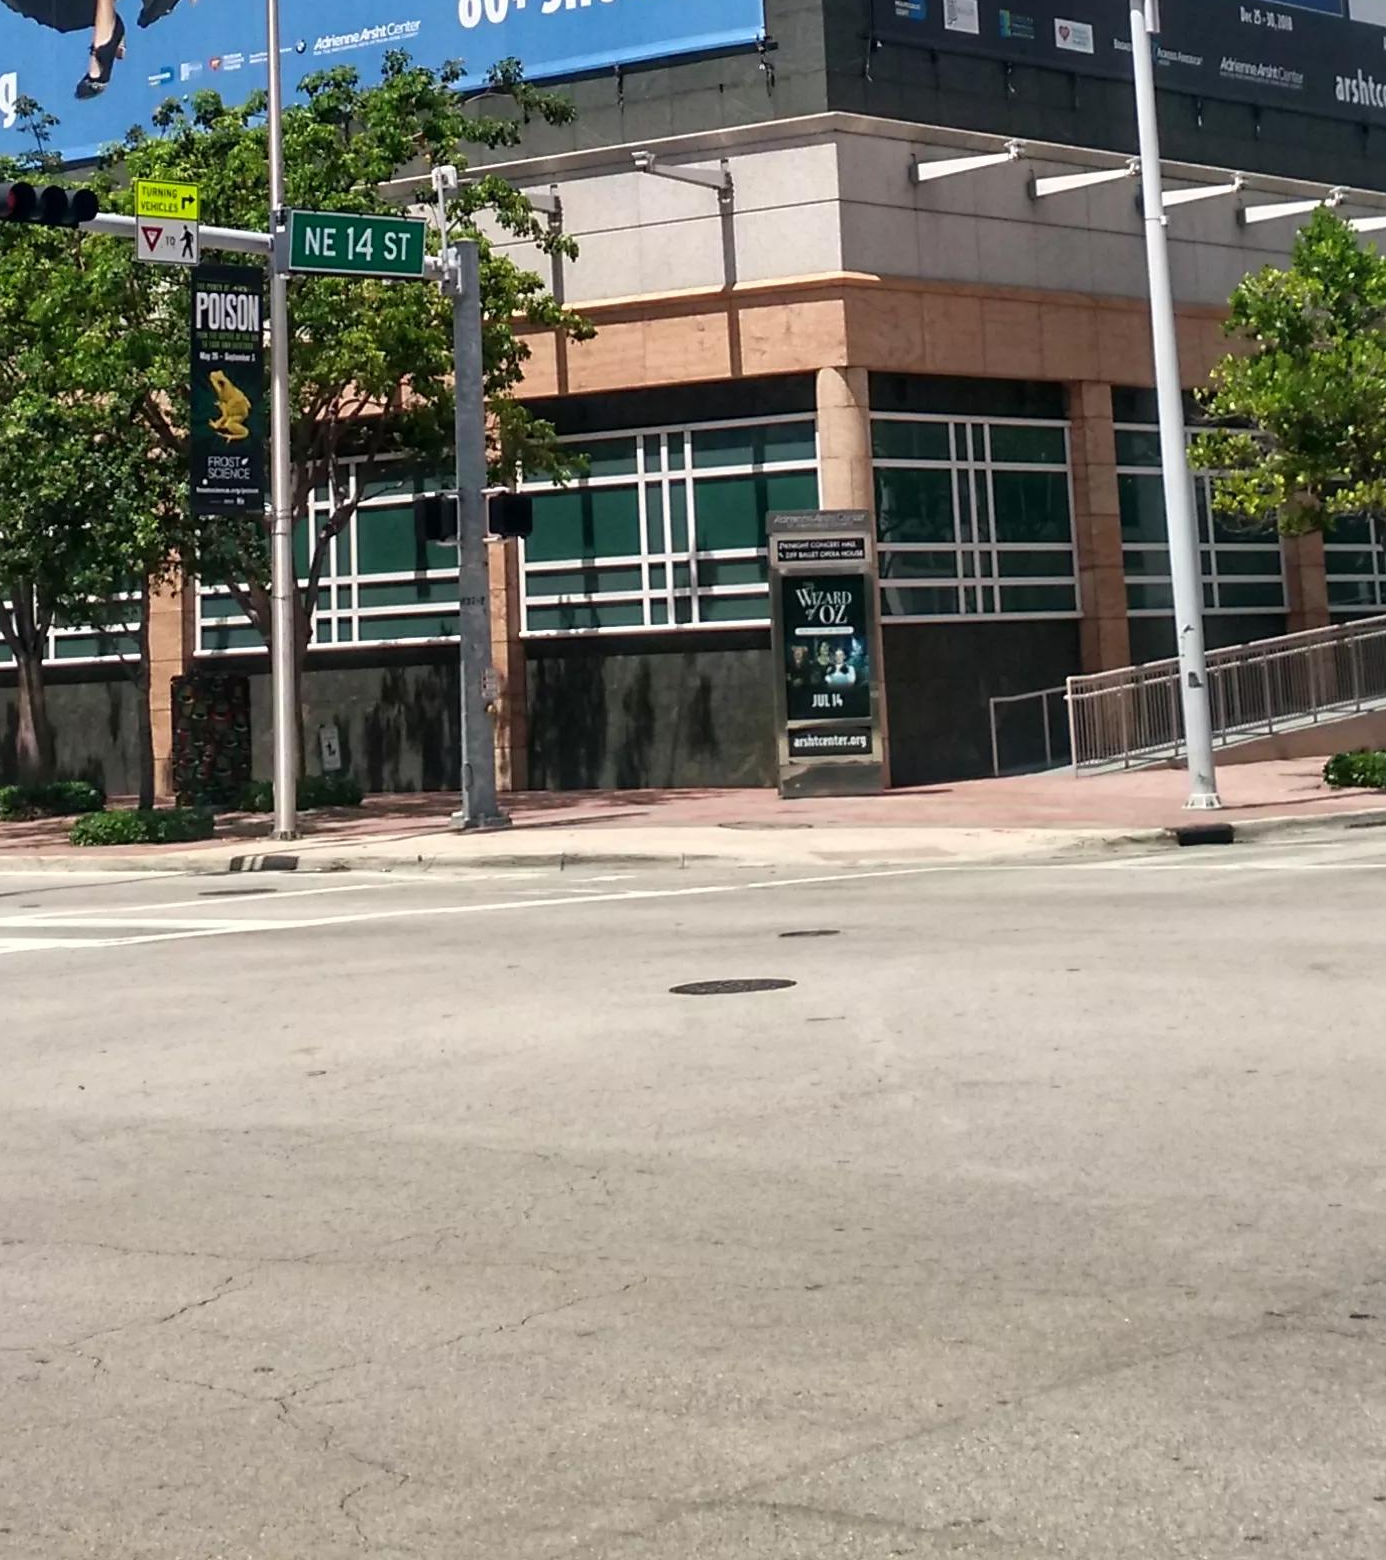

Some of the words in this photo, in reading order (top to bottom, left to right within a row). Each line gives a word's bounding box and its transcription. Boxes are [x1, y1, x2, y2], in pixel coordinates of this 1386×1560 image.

[313, 32, 360, 51] Adrienne
[360, 25, 387, 41] Arsht
[387, 19, 421, 36] Center
[1220, 56, 1257, 76] Adrienne
[1278, 66, 1304, 83] Center
[141, 186, 177, 199] TURNING
[140, 201, 178, 213] VEHICLES
[165, 236, 176, 246] TO
[305, 226, 336, 257] NE
[347, 226, 373, 261] 14
[384, 232, 411, 261] ST
[196, 291, 259, 332] POISON
[208, 456, 241, 467] FROST
[208, 468, 250, 479] SCIENCE
[796, 588, 852, 607] WIZARD
[819, 604, 848, 624] OZ
[812, 693, 830, 708] JUL
[832, 693, 843, 707] 14
[794, 734, 867, 748] arshtcenter.org
